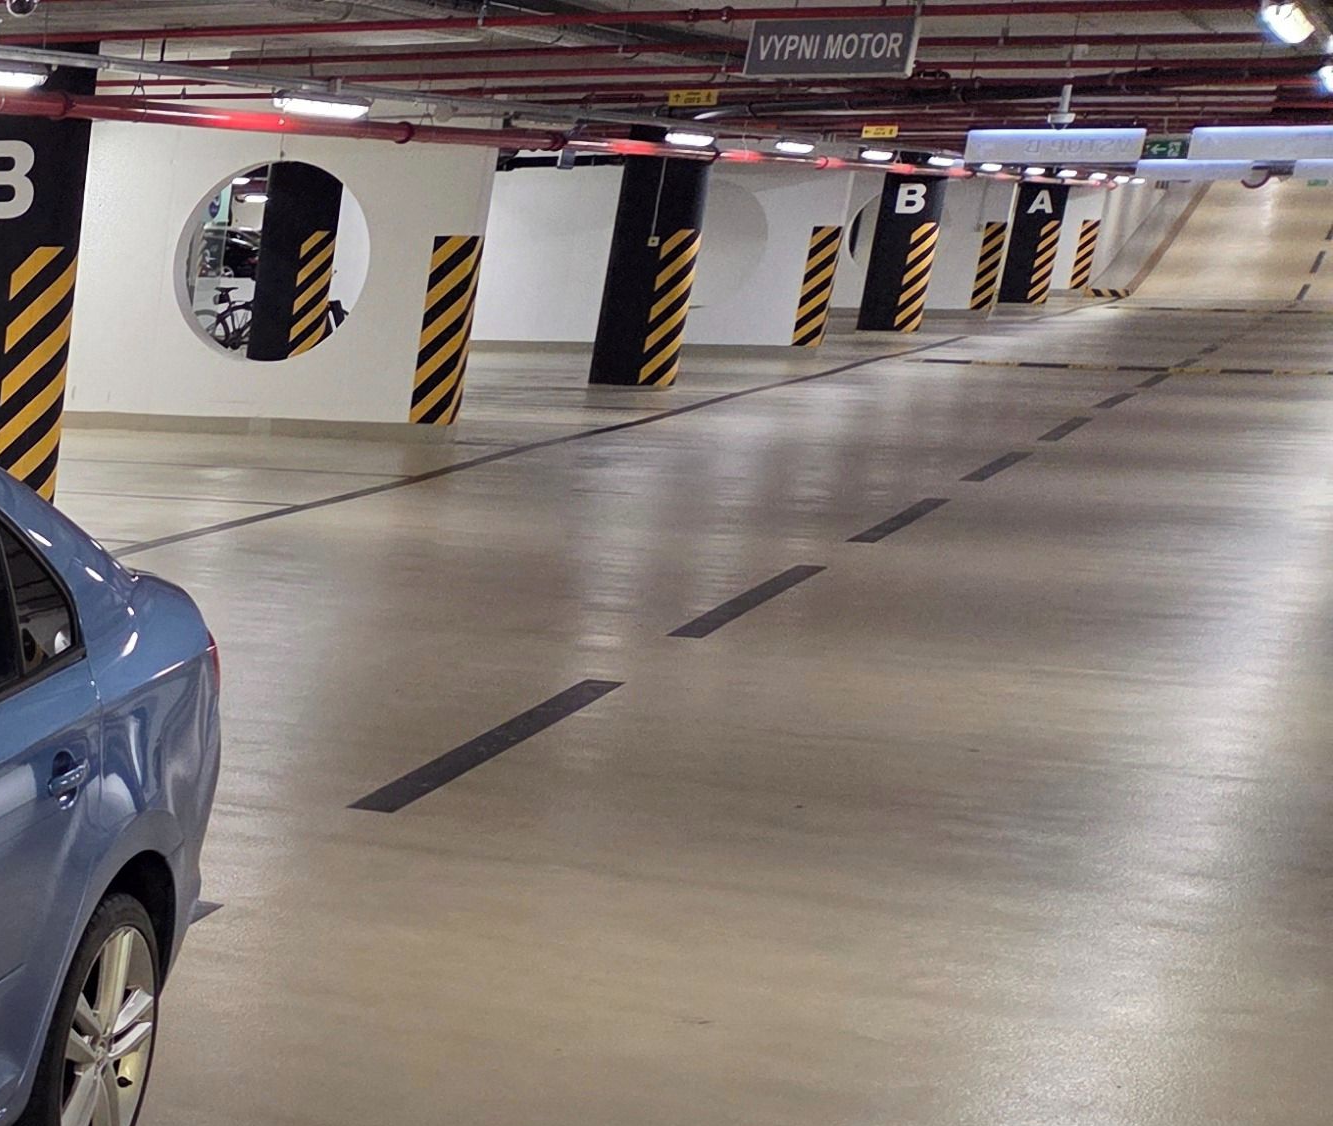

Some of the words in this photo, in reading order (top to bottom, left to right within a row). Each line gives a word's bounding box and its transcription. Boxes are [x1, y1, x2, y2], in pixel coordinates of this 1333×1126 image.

[759, 34, 821, 61] VYPNI
[823, 32, 904, 59] MOTOR
[894, 183, 927, 214] B
[1026, 189, 1054, 214] A
